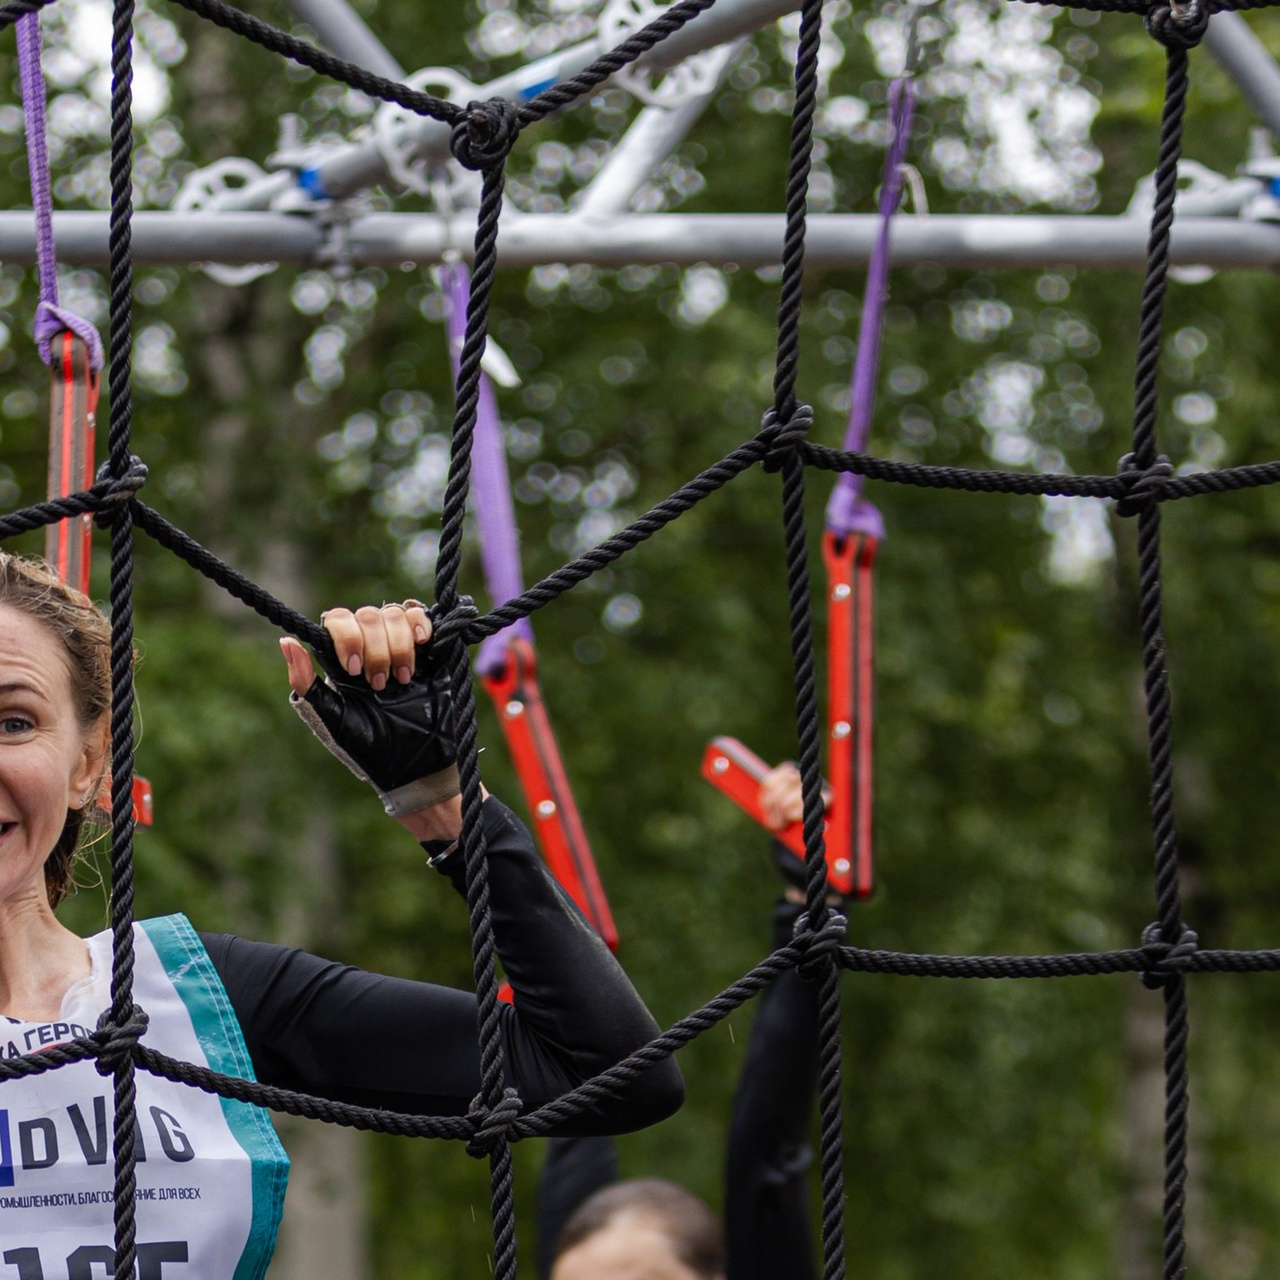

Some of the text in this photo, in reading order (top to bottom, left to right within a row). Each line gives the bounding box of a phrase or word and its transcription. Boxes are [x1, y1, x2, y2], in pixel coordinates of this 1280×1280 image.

[23, 1023, 94, 1050] ГЕРО
[158, 1188, 177, 1200] ДЛЯ
[178, 1187, 201, 1200] ВСЕХ
